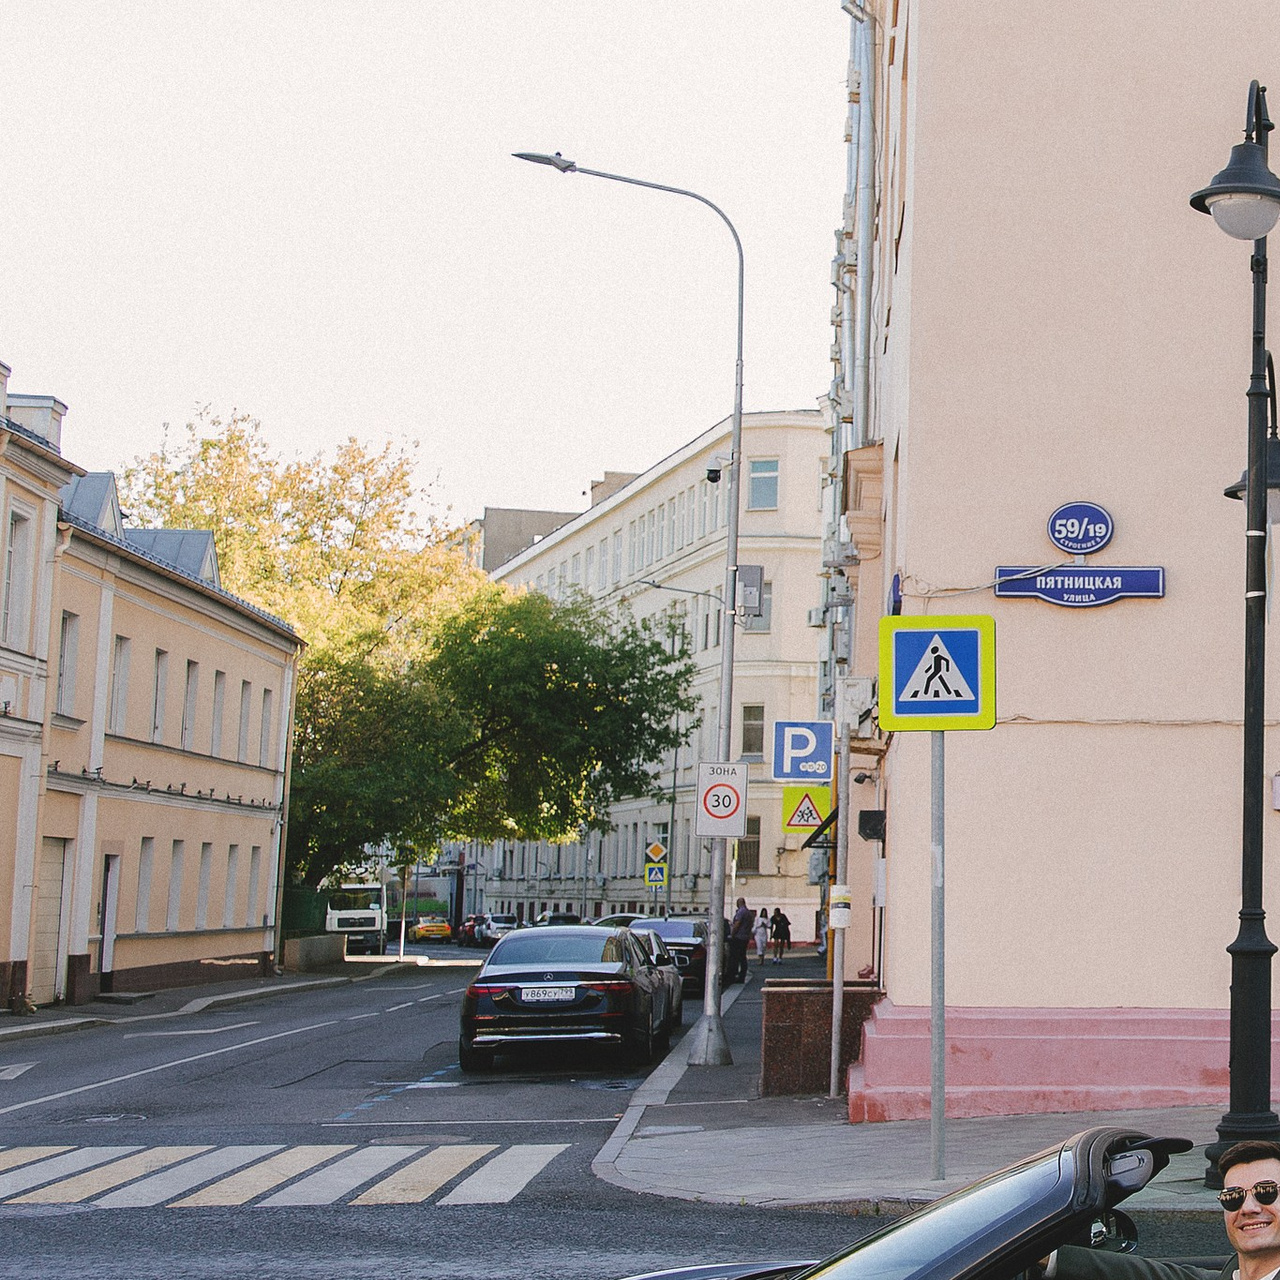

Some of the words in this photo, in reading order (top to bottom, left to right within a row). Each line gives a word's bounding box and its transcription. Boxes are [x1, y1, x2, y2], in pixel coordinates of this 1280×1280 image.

[1054, 517, 1107, 539] 59/19
[1036, 576, 1122, 590] ПЯТНИЦКАЯ
[1063, 593, 1096, 602] УЛИЦА
[783, 726, 817, 774] P
[709, 766, 737, 776] ЗОНА
[711, 794, 732, 808] 30
